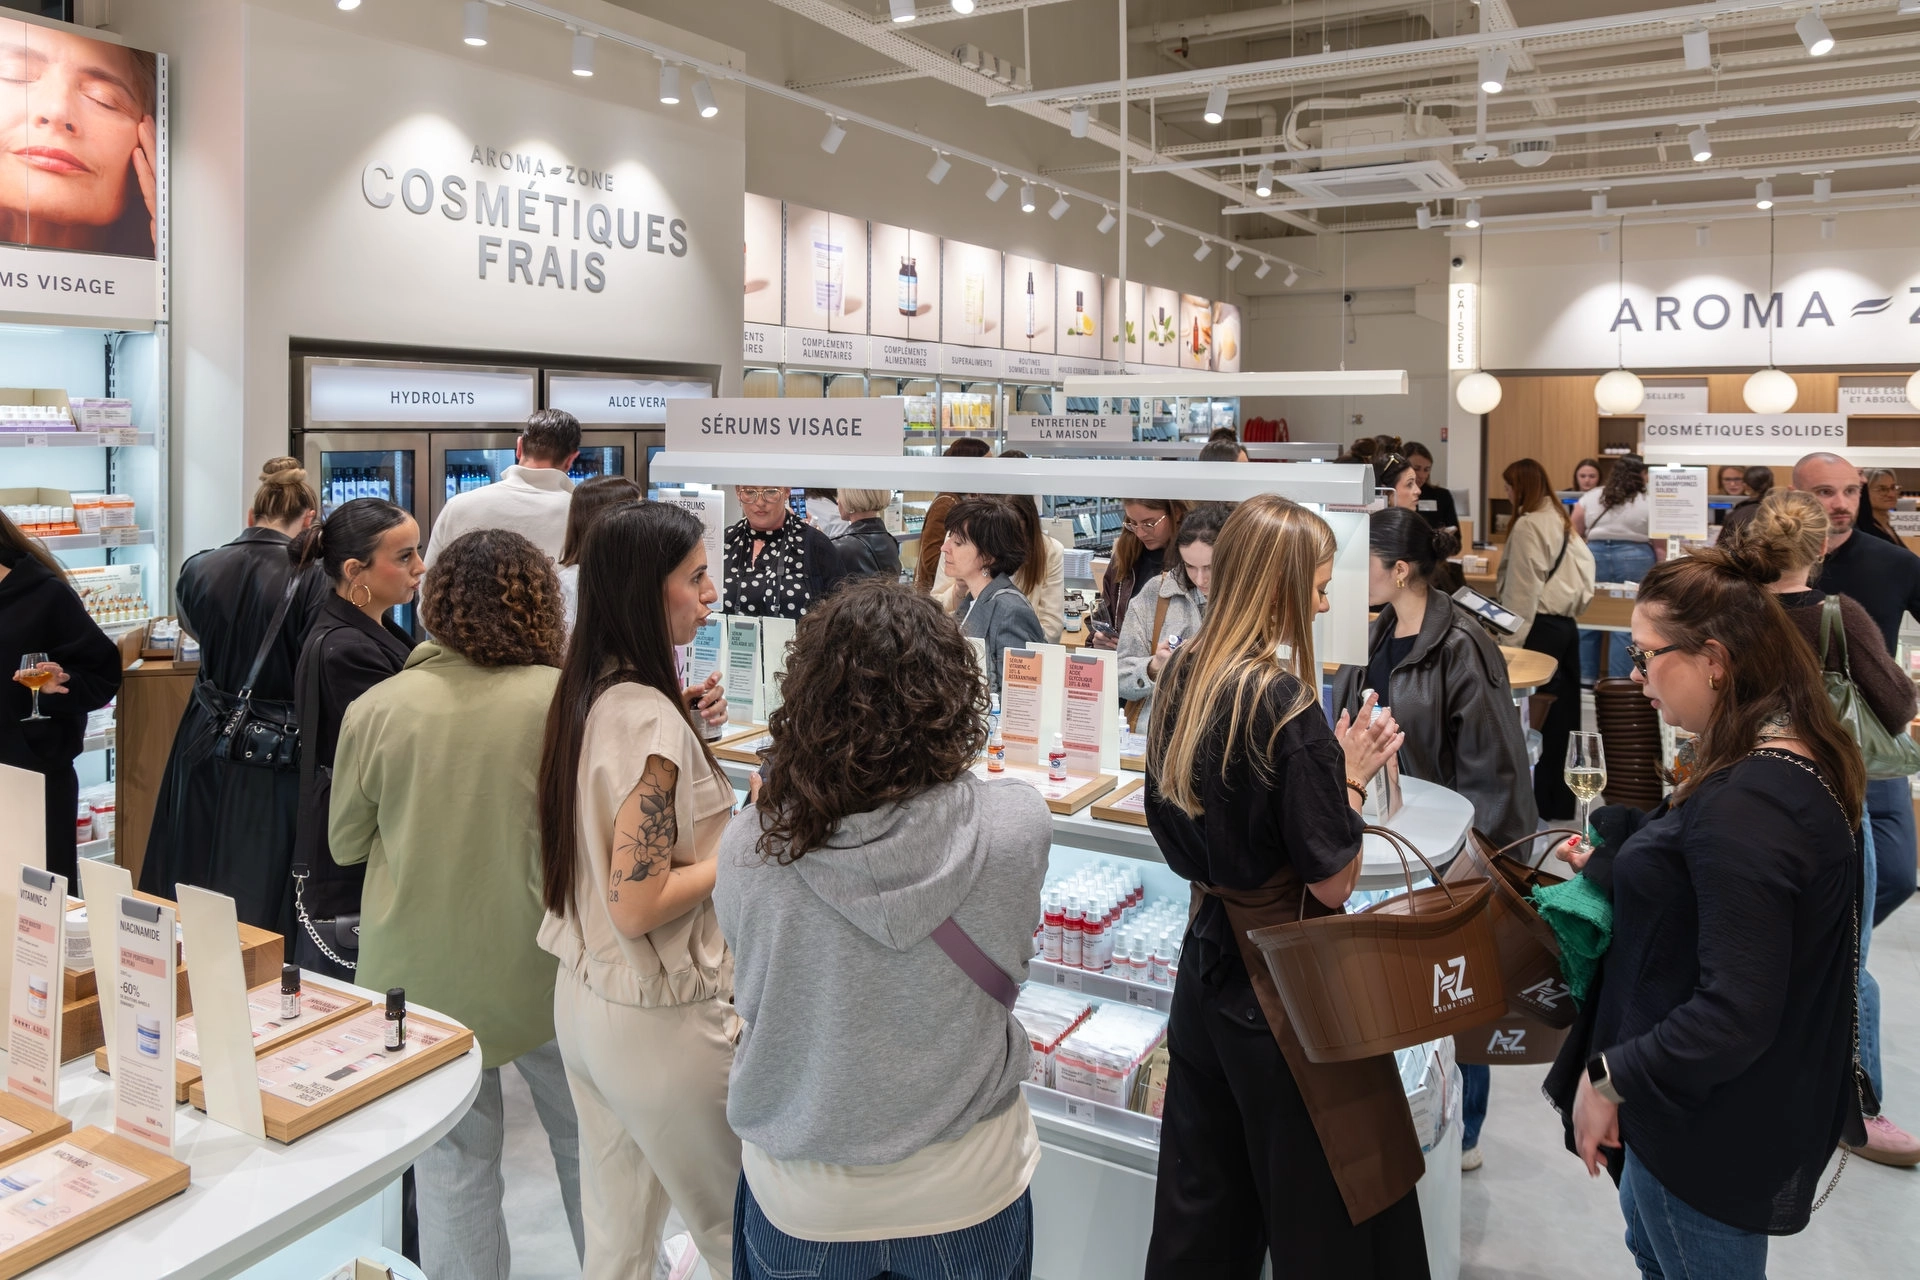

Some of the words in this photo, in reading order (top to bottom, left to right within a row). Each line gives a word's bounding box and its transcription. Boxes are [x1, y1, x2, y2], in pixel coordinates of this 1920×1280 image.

[470, 144, 546, 178] AROMA
[566, 165, 614, 192] ZONE
[361, 159, 688, 258] COSMÉTIQUES
[478, 235, 606, 293] FRAIS
[38, 274, 116, 295] VISAGE
[1609, 291, 1835, 332] AROMA
[1457, 289, 1465, 363] CAISSES
[802, 336, 853, 350] COMPLÉMENTS
[802, 349, 852, 361] ALIMENTAIRES
[884, 345, 928, 357] COMPLÉMENTS
[884, 356, 927, 367] ALIMENTAIRES
[951, 356, 993, 368] SUPERALIMENTS
[1018, 357, 1041, 366] ROUTINES
[1008, 366, 1029, 375] SOMMEIL
[1034, 368, 1050, 376] STRESS
[390, 391, 475, 405] HYDROLATS
[608, 396, 636, 408] ALOE
[639, 396, 666, 408] VERA
[701, 413, 781, 435] SÉRUMS
[788, 417, 862, 436] VISAGE
[1031, 418, 1089, 428] ENTRETIEN
[1093, 418, 1107, 428] DE
[1647, 422, 1765, 437] COSMÉTIQUES
[1771, 424, 1844, 437] SOLIDES
[1040, 430, 1052, 439] LA
[1055, 430, 1098, 439] MAISON
[612, 869, 623, 887] 19
[20, 888, 43, 906] VITAMINE
[43, 897, 48, 907] C
[609, 890, 619, 903] 28
[120, 920, 160, 942] NIACINAMIDE
[120, 982, 140, 998] -60%
[1487, 1030, 1526, 1051] AZ
